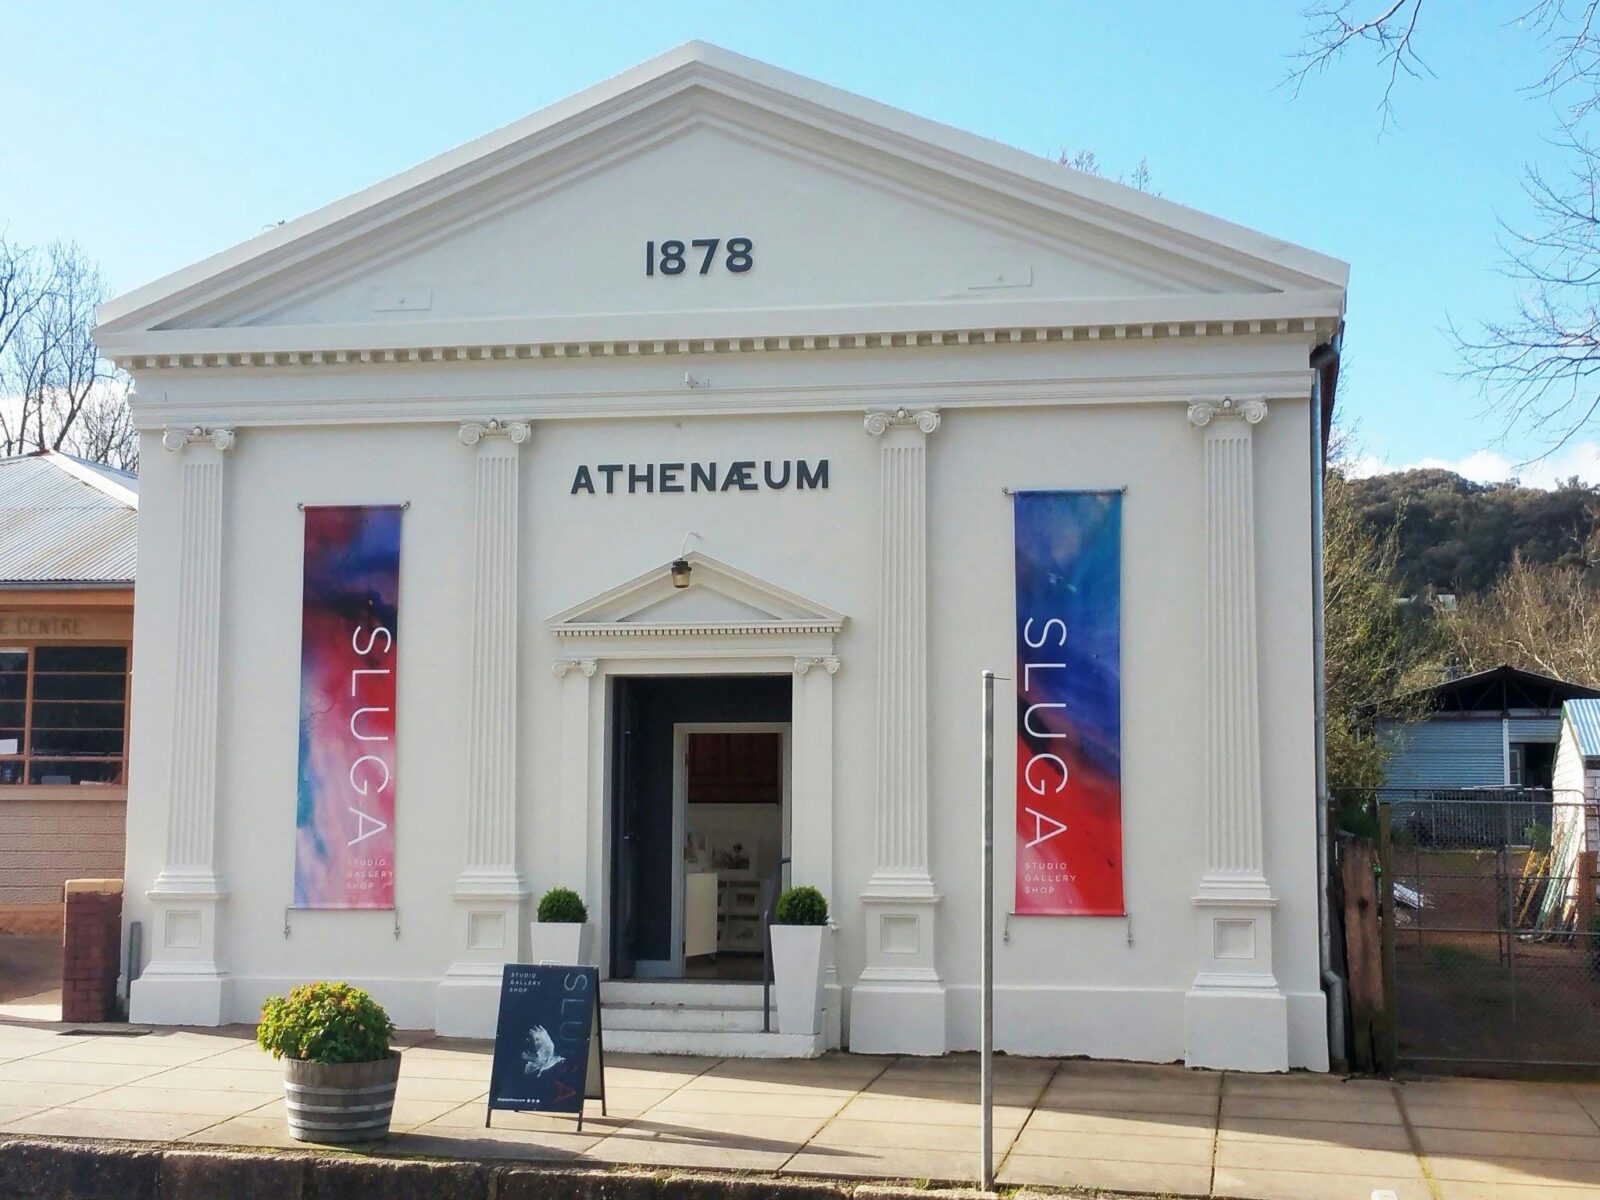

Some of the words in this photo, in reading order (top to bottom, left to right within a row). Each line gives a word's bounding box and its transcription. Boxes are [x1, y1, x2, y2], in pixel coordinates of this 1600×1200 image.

[646, 237, 753, 276] 1878
[570, 459, 829, 494] ATHENÆUM
[17, 616, 82, 636] CENTRE
[348, 625, 392, 846] SLUGA
[1024, 618, 1068, 849] SLUGA
[346, 870, 393, 878] GALLERY
[1024, 862, 1067, 870] STUDIO
[1024, 874, 1076, 882] GALLERY
[1024, 886, 1055, 894] SHOP
